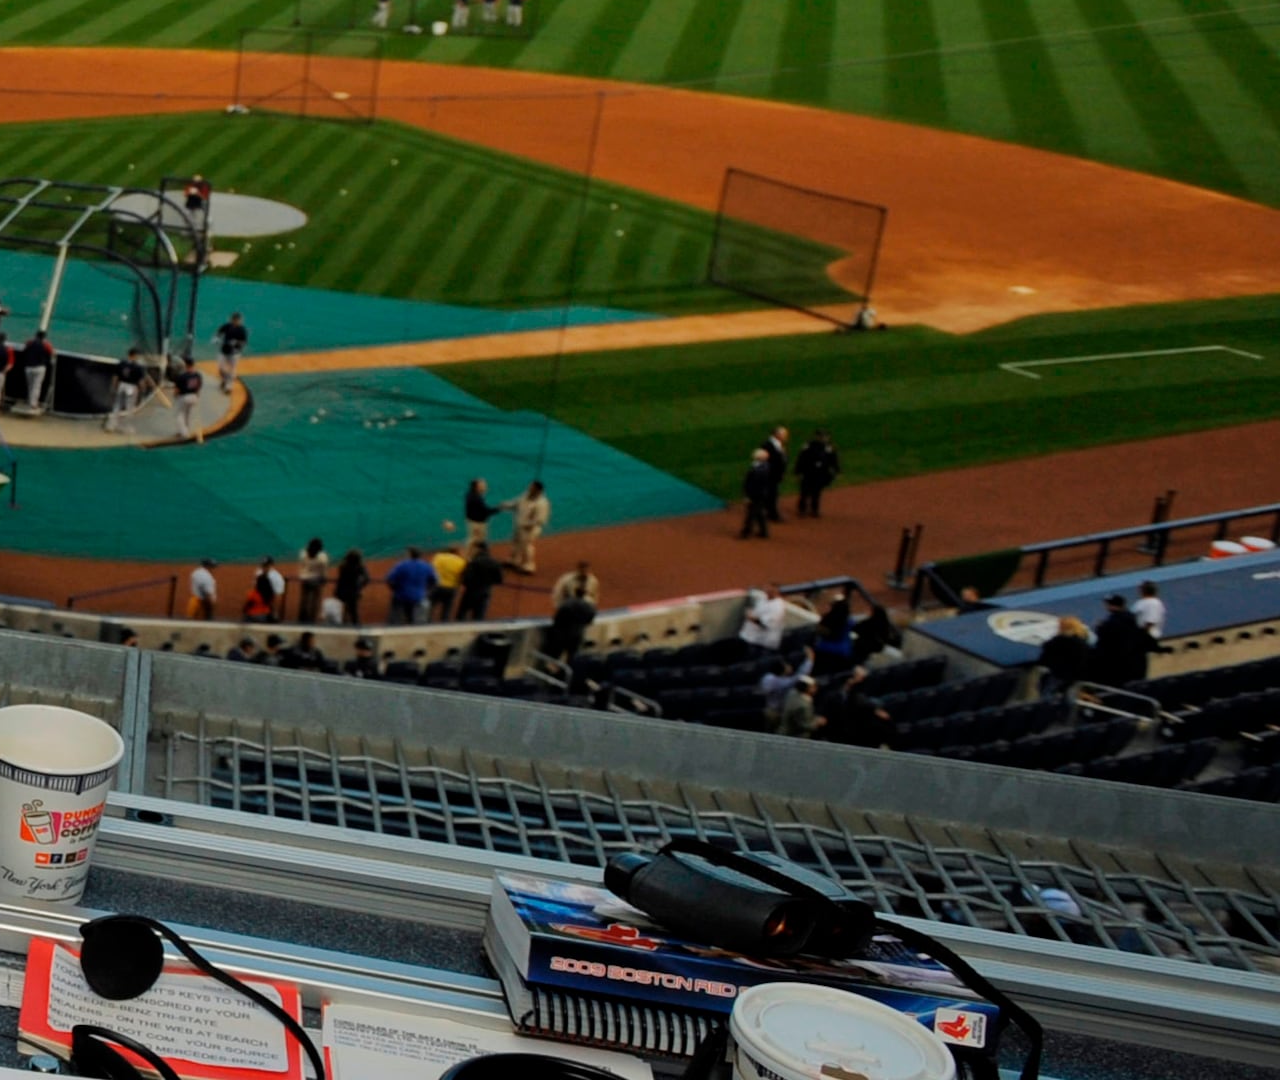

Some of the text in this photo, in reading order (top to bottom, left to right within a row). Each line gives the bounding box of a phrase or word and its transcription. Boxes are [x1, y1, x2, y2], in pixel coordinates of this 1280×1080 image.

[1, 865, 28, 887] New
[26, 876, 60, 894] York
[550, 956, 607, 977] 2009
[607, 965, 691, 992] BOSTON
[694, 977, 736, 998] RED
[179, 990, 211, 1003] KEYS
[215, 995, 231, 1005] TO
[195, 1005, 212, 1015] BY
[215, 1007, 251, 1021] YOUR
[139, 1018, 162, 1029] THE
[165, 1023, 192, 1035] WEB
[196, 1028, 212, 1038] AT
[215, 1032, 269, 1048] SEARCH
[146, 1032, 175, 1044] COM
[185, 1040, 222, 1052] YOUR
[224, 1045, 280, 1060] SOURCE
